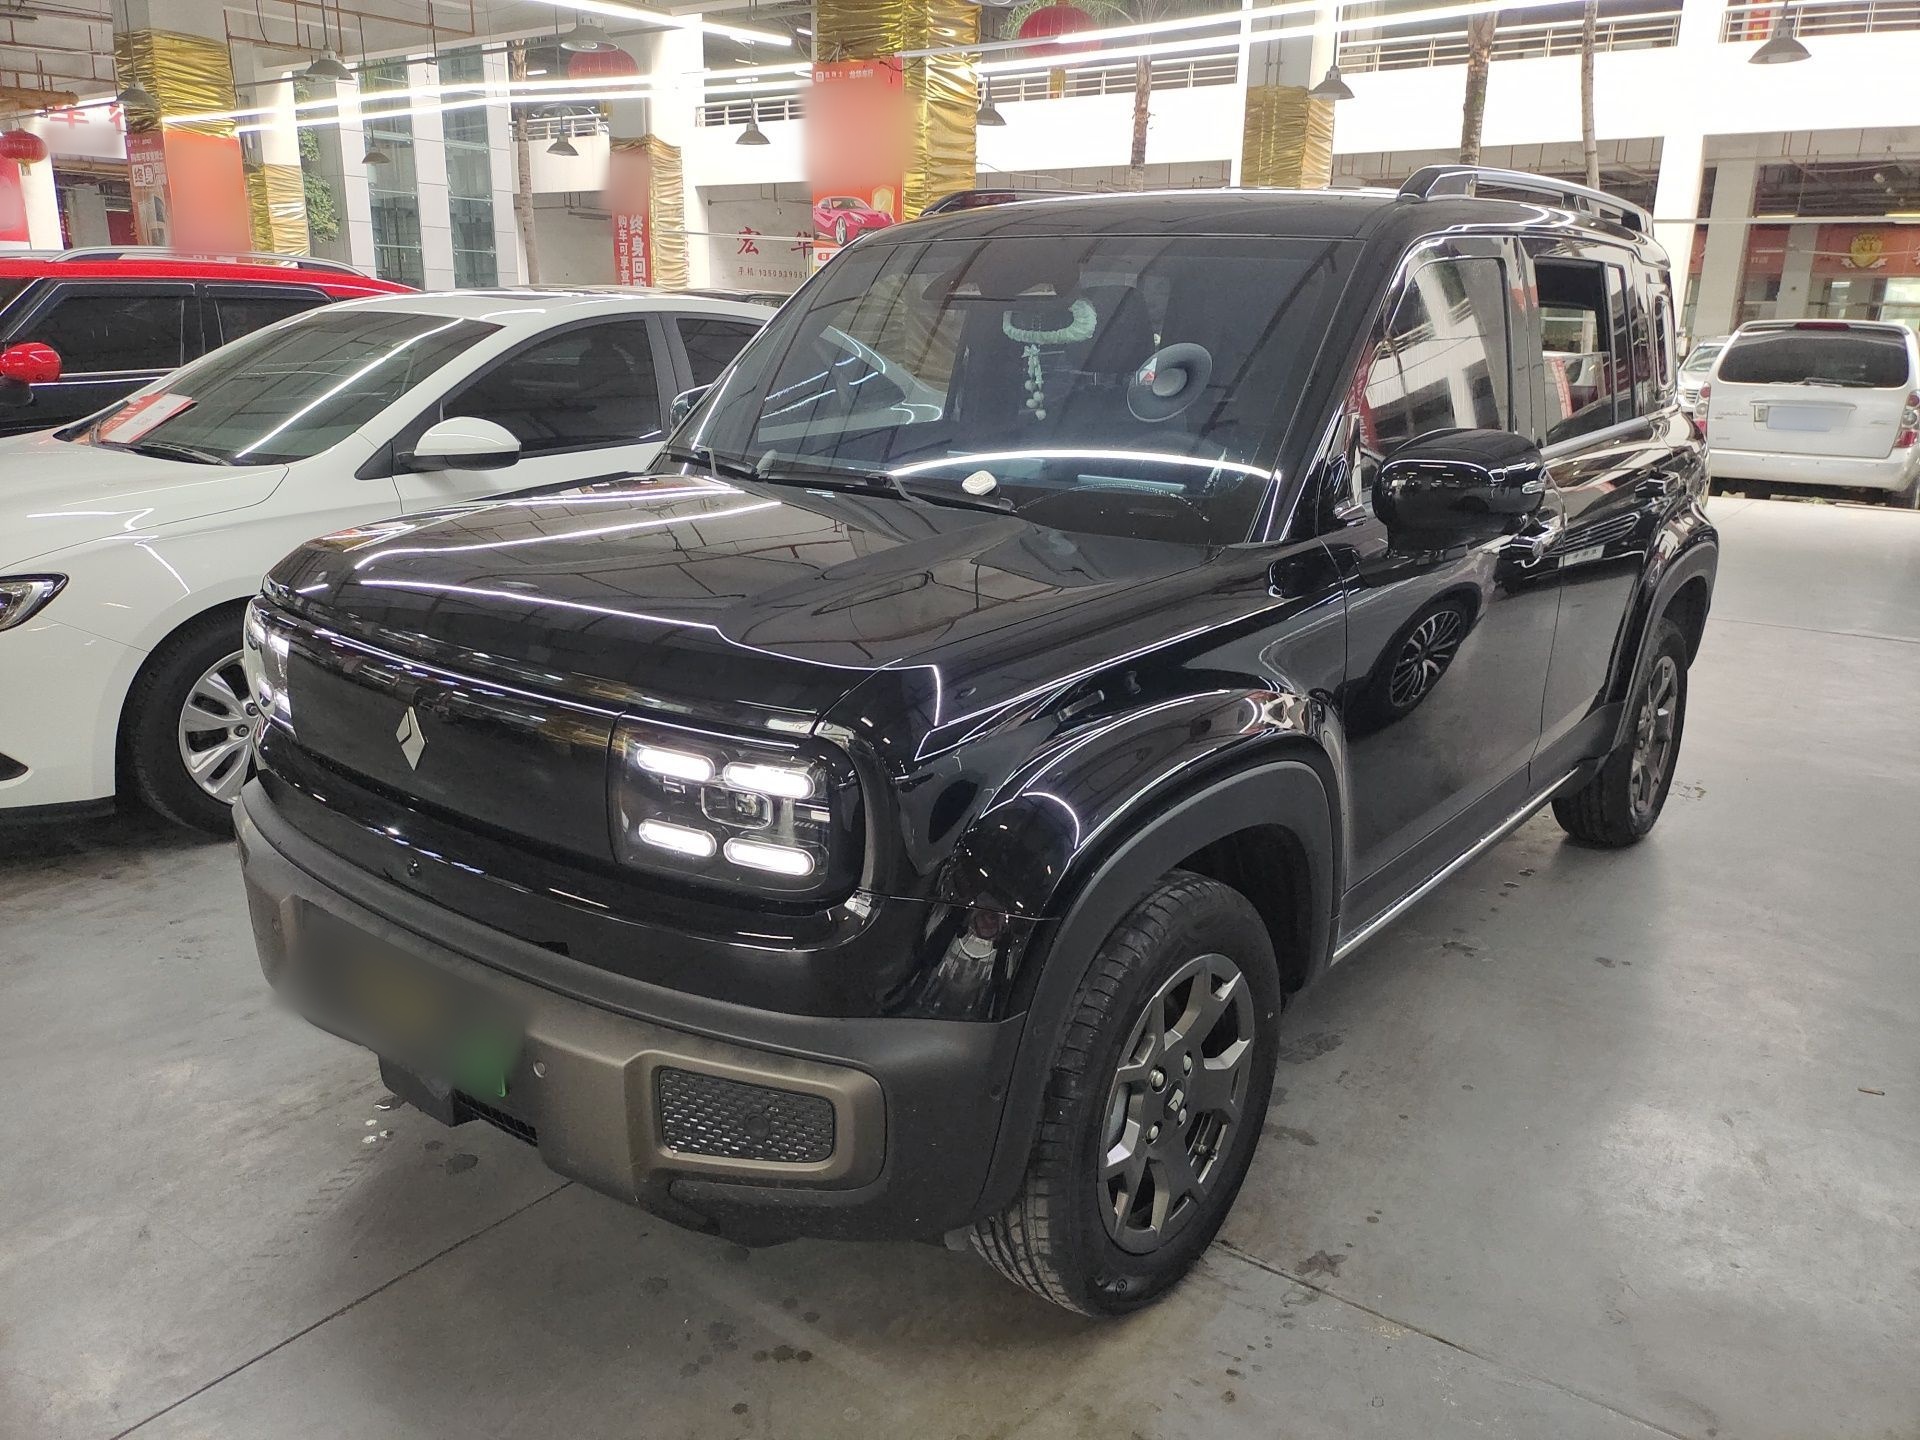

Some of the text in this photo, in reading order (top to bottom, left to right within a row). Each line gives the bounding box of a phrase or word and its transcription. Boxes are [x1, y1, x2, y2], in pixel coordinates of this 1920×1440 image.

[618, 215, 630, 287] 购车可享查
